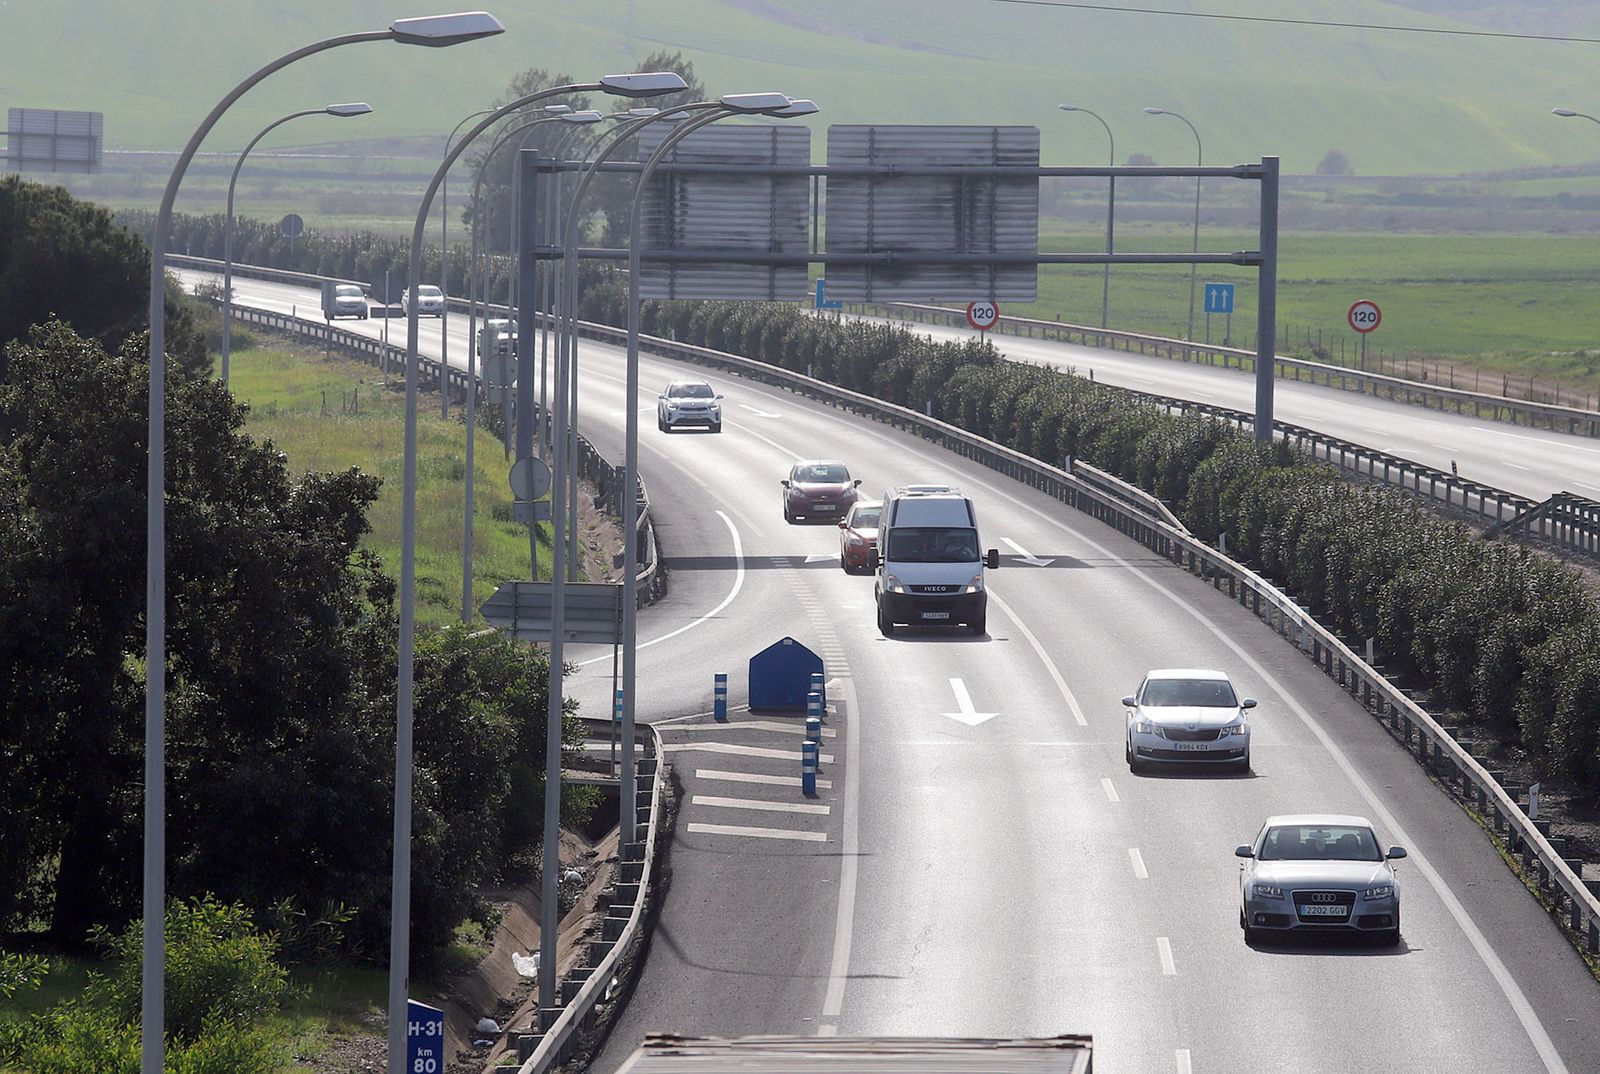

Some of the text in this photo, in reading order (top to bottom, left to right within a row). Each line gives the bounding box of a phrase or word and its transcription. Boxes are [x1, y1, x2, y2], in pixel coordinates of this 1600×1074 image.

[972, 307, 994, 319] 120
[1353, 311, 1377, 323] 120
[1306, 906, 1346, 915] 2202 GGV
[408, 1020, 443, 1036] H-31
[417, 1047, 433, 1057] km
[413, 1058, 437, 1074] 80
